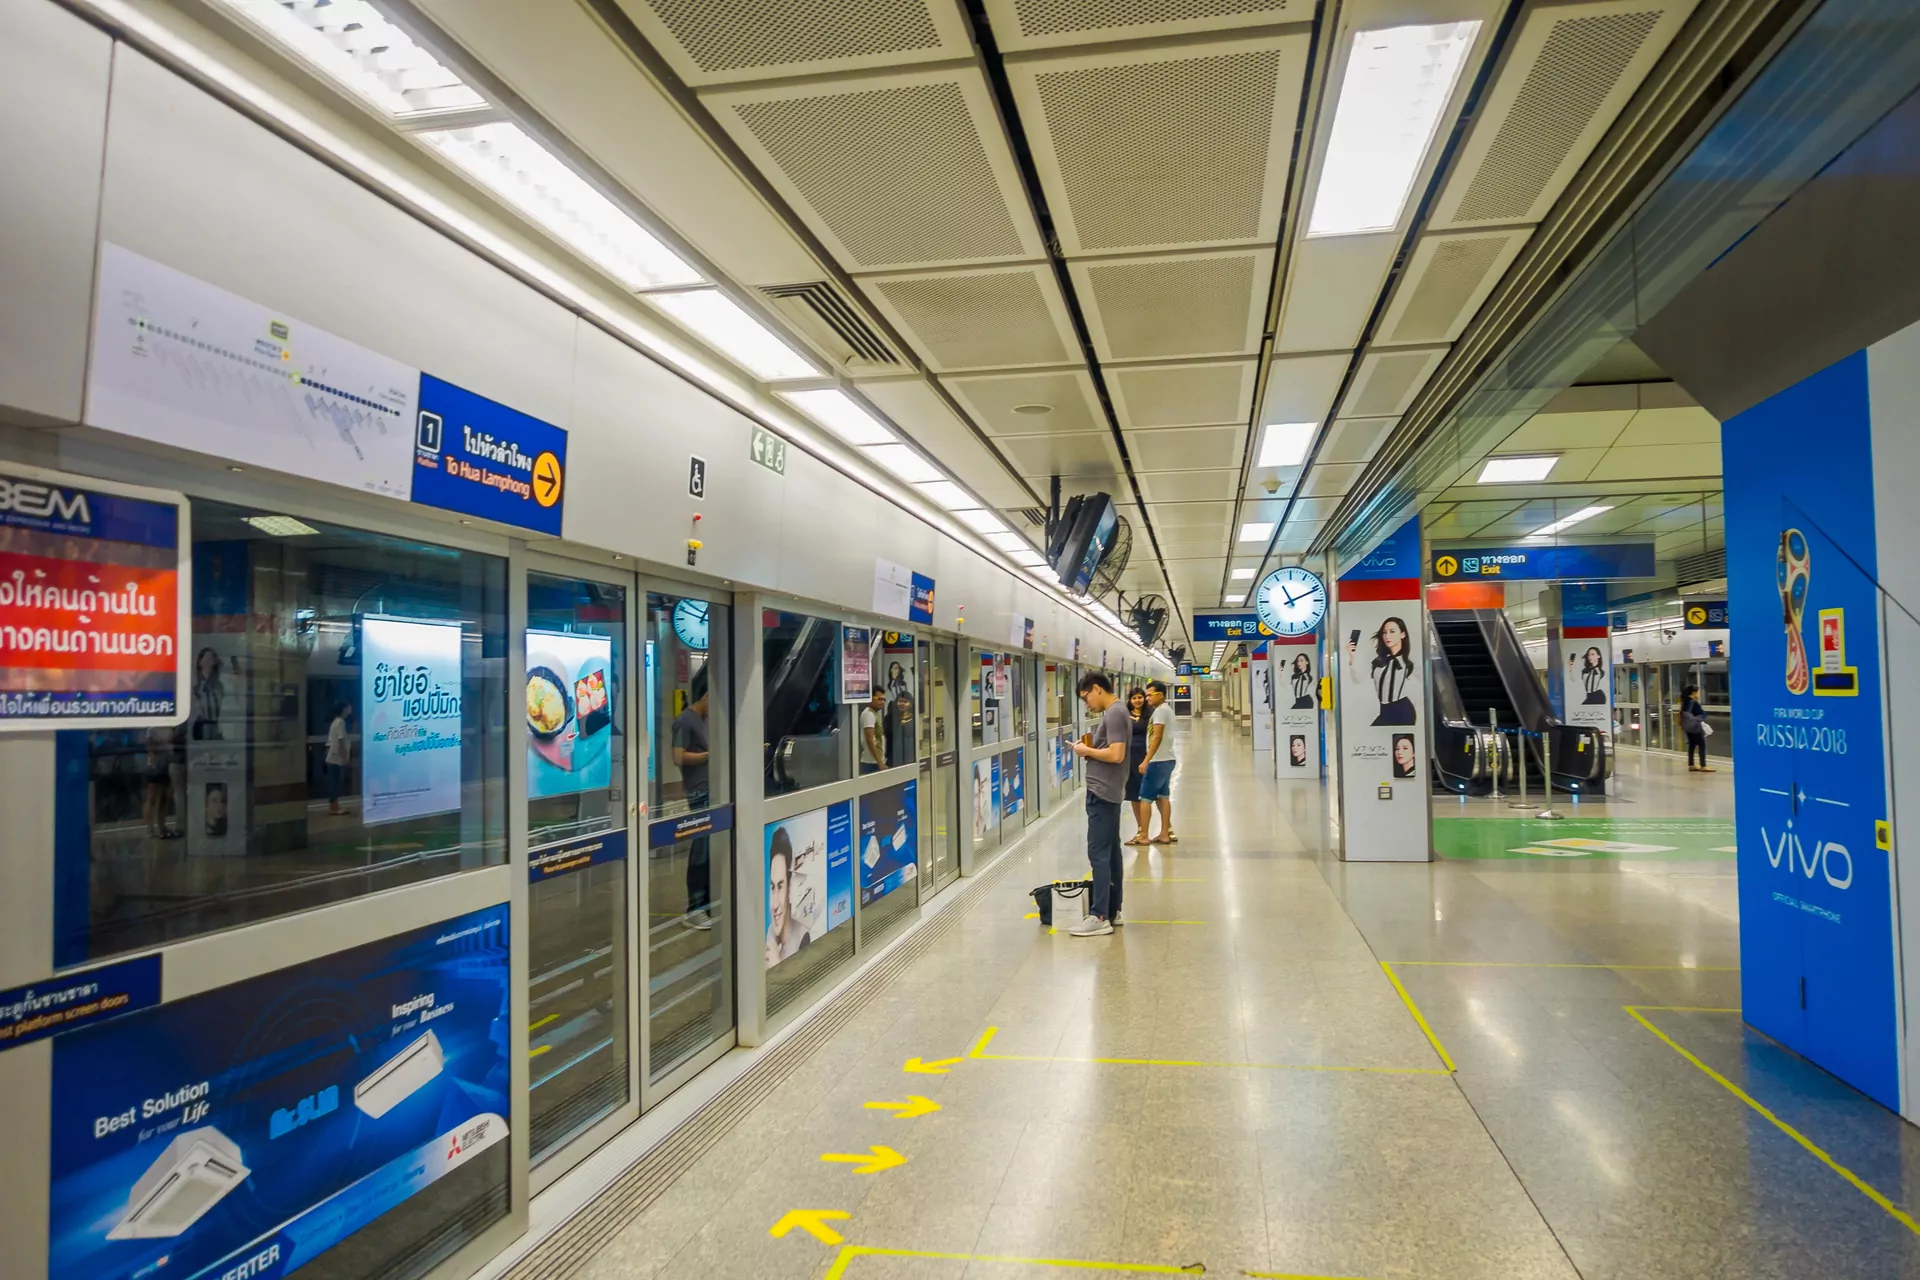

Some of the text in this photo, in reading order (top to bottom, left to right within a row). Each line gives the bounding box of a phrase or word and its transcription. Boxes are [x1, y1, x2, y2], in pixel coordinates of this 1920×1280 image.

[426, 422, 434, 444] 1
[463, 424, 533, 472] ไปหัวลำโพง
[445, 455, 531, 500] To Hua Lamphong
[1480, 554, 1526, 564] ทางออก
[1481, 564, 1501, 575] Exit
[0, 615, 173, 656] างคนด้านนอก
[1227, 628, 1242, 636] Exit
[1773, 707, 1825, 721] FIFA WORLD CUP
[1757, 723, 1848, 755] RUSSIA 2018
[1761, 818, 1853, 890] vivo
[15, 1011, 64, 1037] platform
[64, 1003, 100, 1021] screen
[100, 993, 130, 1010] doors
[391, 992, 435, 1019] Inspiring
[420, 1001, 456, 1024] Business
[94, 1081, 210, 1138] Best Solution
[181, 1100, 211, 1125] Life
[216, 1243, 281, 1280] ERTER
